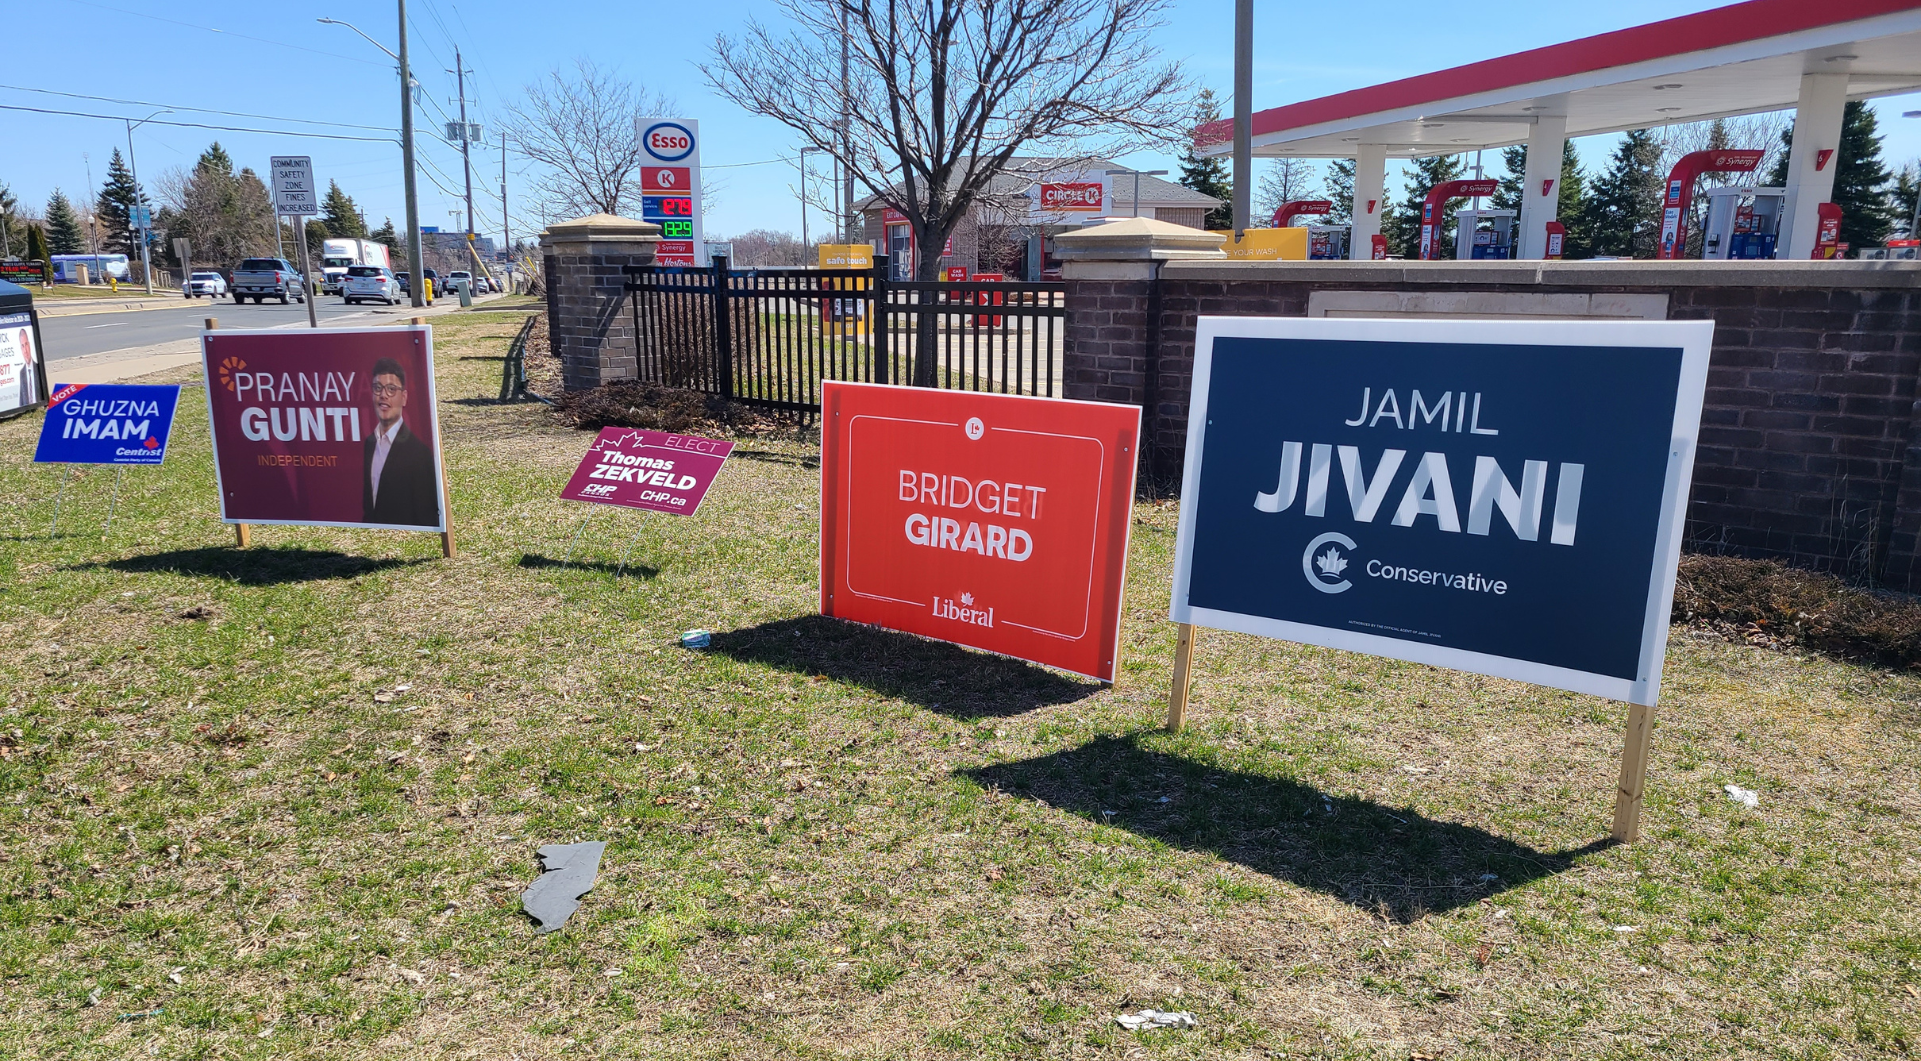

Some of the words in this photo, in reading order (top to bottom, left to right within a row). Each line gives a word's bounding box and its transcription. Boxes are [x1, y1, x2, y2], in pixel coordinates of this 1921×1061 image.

[652, 133, 688, 148] Esso
[273, 160, 309, 168] COMMUNITY
[1726, 158, 1755, 166] Synergy
[280, 170, 305, 178] SAFETY
[660, 171, 673, 188] K
[285, 182, 304, 190] ZONE
[1046, 190, 1082, 201] CIRCLE
[280, 204, 315, 212] INCREASED
[52, 384, 77, 402] VOTE
[235, 372, 356, 402] PRANAY
[62, 399, 160, 417] GHUZNA
[1345, 386, 1499, 436] JAMIL
[62, 418, 150, 440] IMAM
[240, 406, 361, 442] GUNTI
[116, 447, 162, 456] Centrist
[664, 436, 720, 452] ELECT
[258, 454, 338, 467] INDEPENDENT
[602, 450, 675, 471] Thomas
[589, 464, 696, 490] ZEKVELD
[584, 484, 617, 494] CHP
[899, 469, 1046, 520] BRIDGET
[1253, 440, 1585, 546] JIVANI
[640, 490, 686, 506] CHP.ca
[905, 513, 1033, 562] GIRARD
[1366, 559, 1508, 595] Conservative
[932, 596, 994, 628] Liberal
